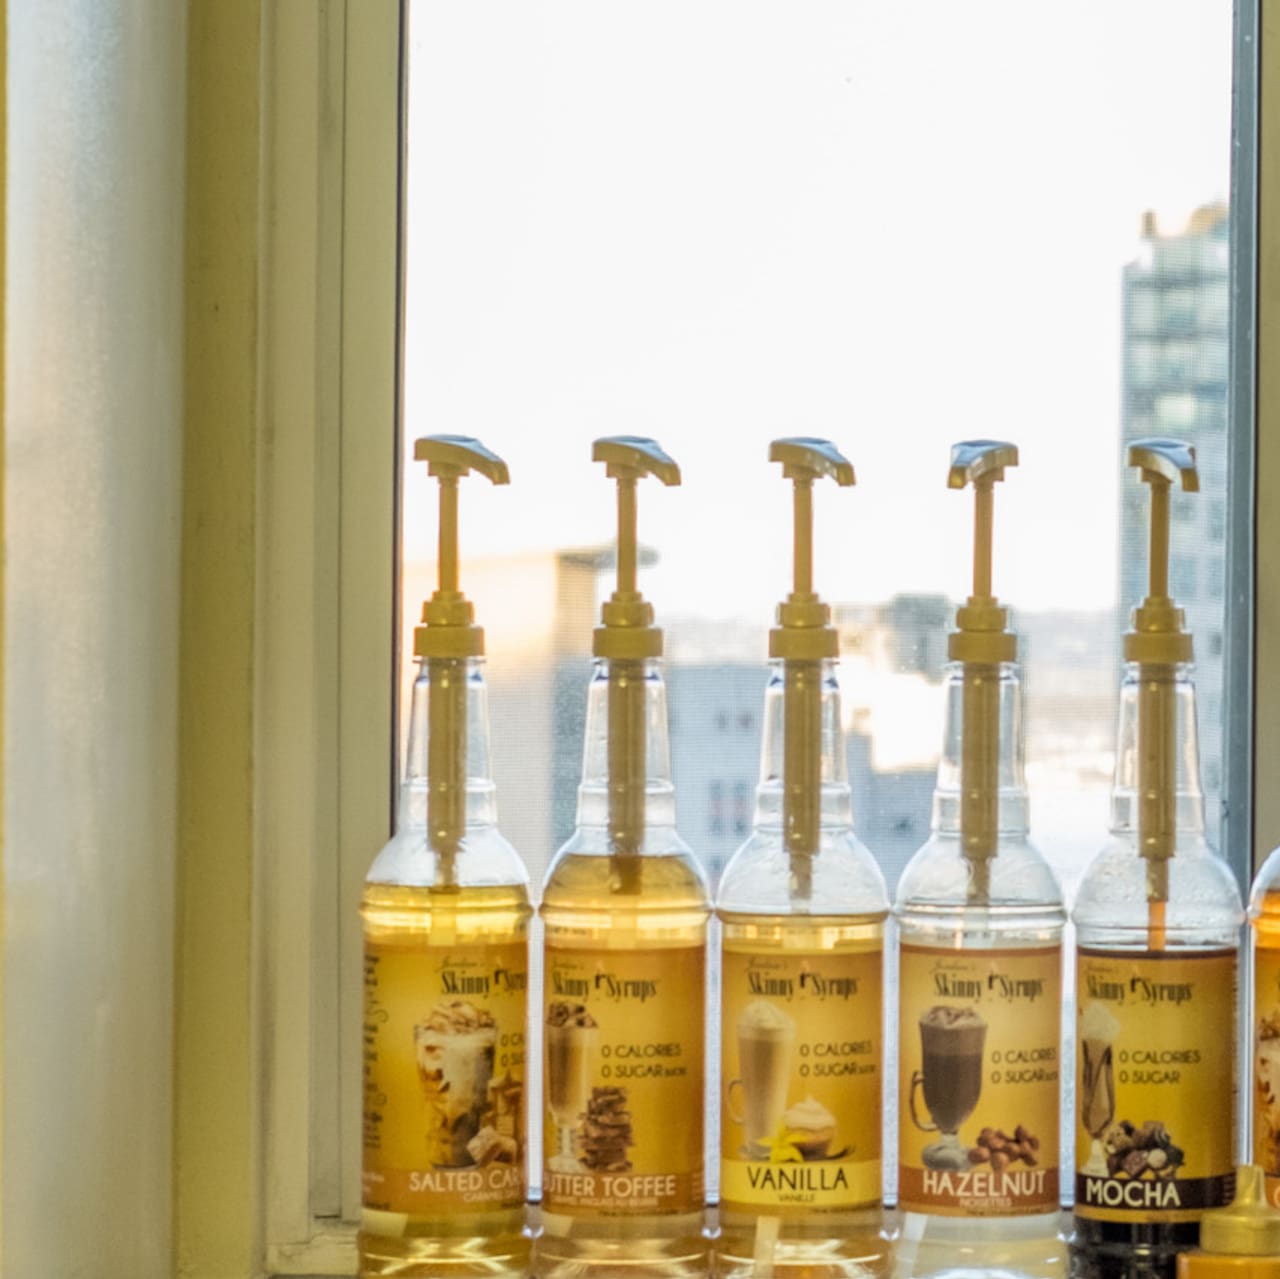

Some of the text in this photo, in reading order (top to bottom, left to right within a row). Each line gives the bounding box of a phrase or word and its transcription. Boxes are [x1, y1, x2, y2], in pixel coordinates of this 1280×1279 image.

[615, 1042, 682, 1058] CALORIES
[1131, 1050, 1201, 1064] CALORIES
[615, 1064, 663, 1078] SUGAR
[1132, 1070, 1180, 1084] SUGAR
[409, 1171, 484, 1193] SALTED
[602, 1174, 676, 1198] TOFFEE
[747, 1166, 849, 1191] VANILLA
[922, 1170, 1046, 1198] HAZELNUT
[1086, 1178, 1181, 1207] MOCHA
